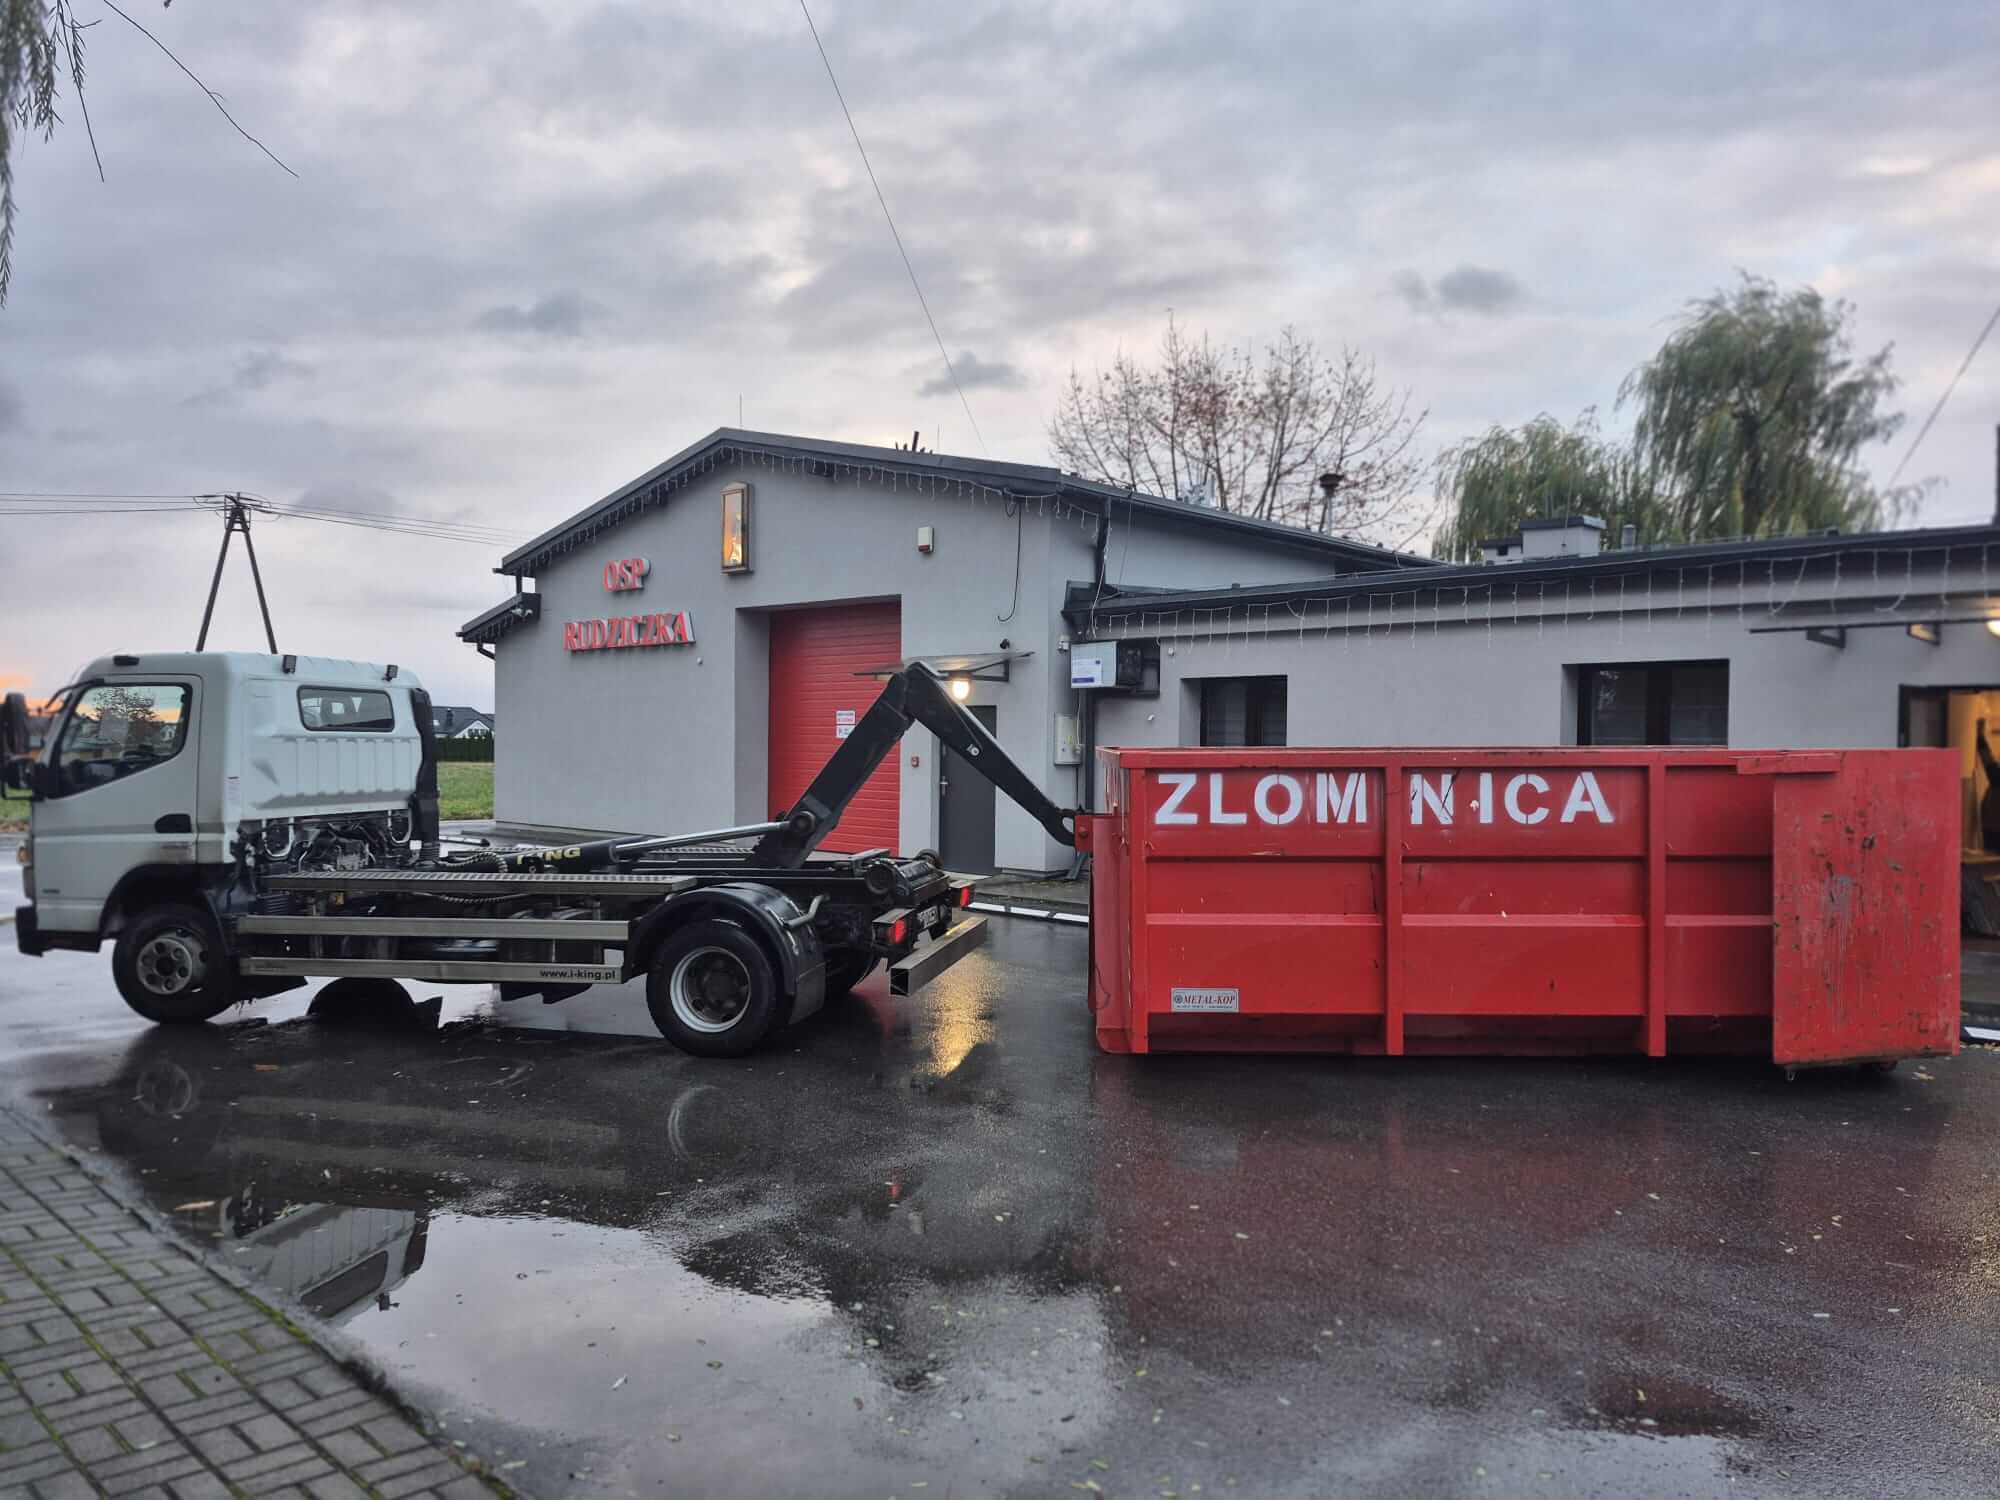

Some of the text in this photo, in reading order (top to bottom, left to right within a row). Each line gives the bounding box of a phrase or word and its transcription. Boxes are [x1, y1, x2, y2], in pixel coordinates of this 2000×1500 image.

[603, 559, 648, 592] OSP
[563, 611, 694, 651] RUDZICZKA
[540, 969, 616, 981] www.i-king.pl
[1184, 995, 1235, 1004] METAL-KOP
